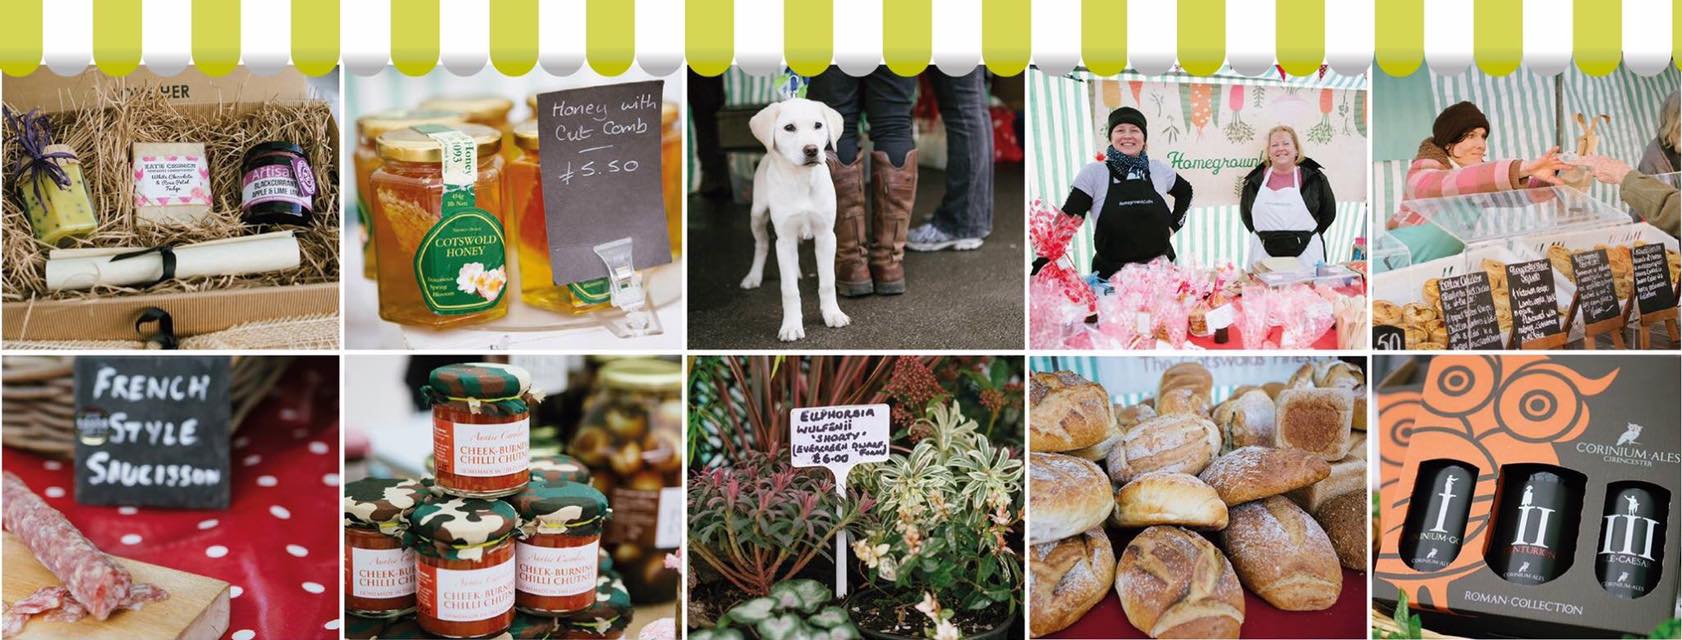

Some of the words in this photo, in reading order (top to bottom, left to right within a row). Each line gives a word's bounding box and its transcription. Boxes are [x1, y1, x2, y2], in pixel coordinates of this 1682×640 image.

[552, 100, 608, 122] Honey
[620, 94, 656, 110] with
[556, 125, 594, 140] Cut
[603, 118, 648, 134] Comb
[464, 142, 474, 176] Honey
[435, 236, 497, 247] COTSWOLD
[446, 246, 486, 257] HONEY
[93, 366, 210, 400] FRENCH
[800, 408, 874, 422] EUPHORBIA
[109, 412, 198, 446] STYLE
[460, 455, 495, 464] CHILLI
[1598, 514, 1660, 562] III
[360, 578, 395, 587] CHILLI
[520, 572, 550, 584] CHILLI
[444, 601, 480, 609] CHILLI
